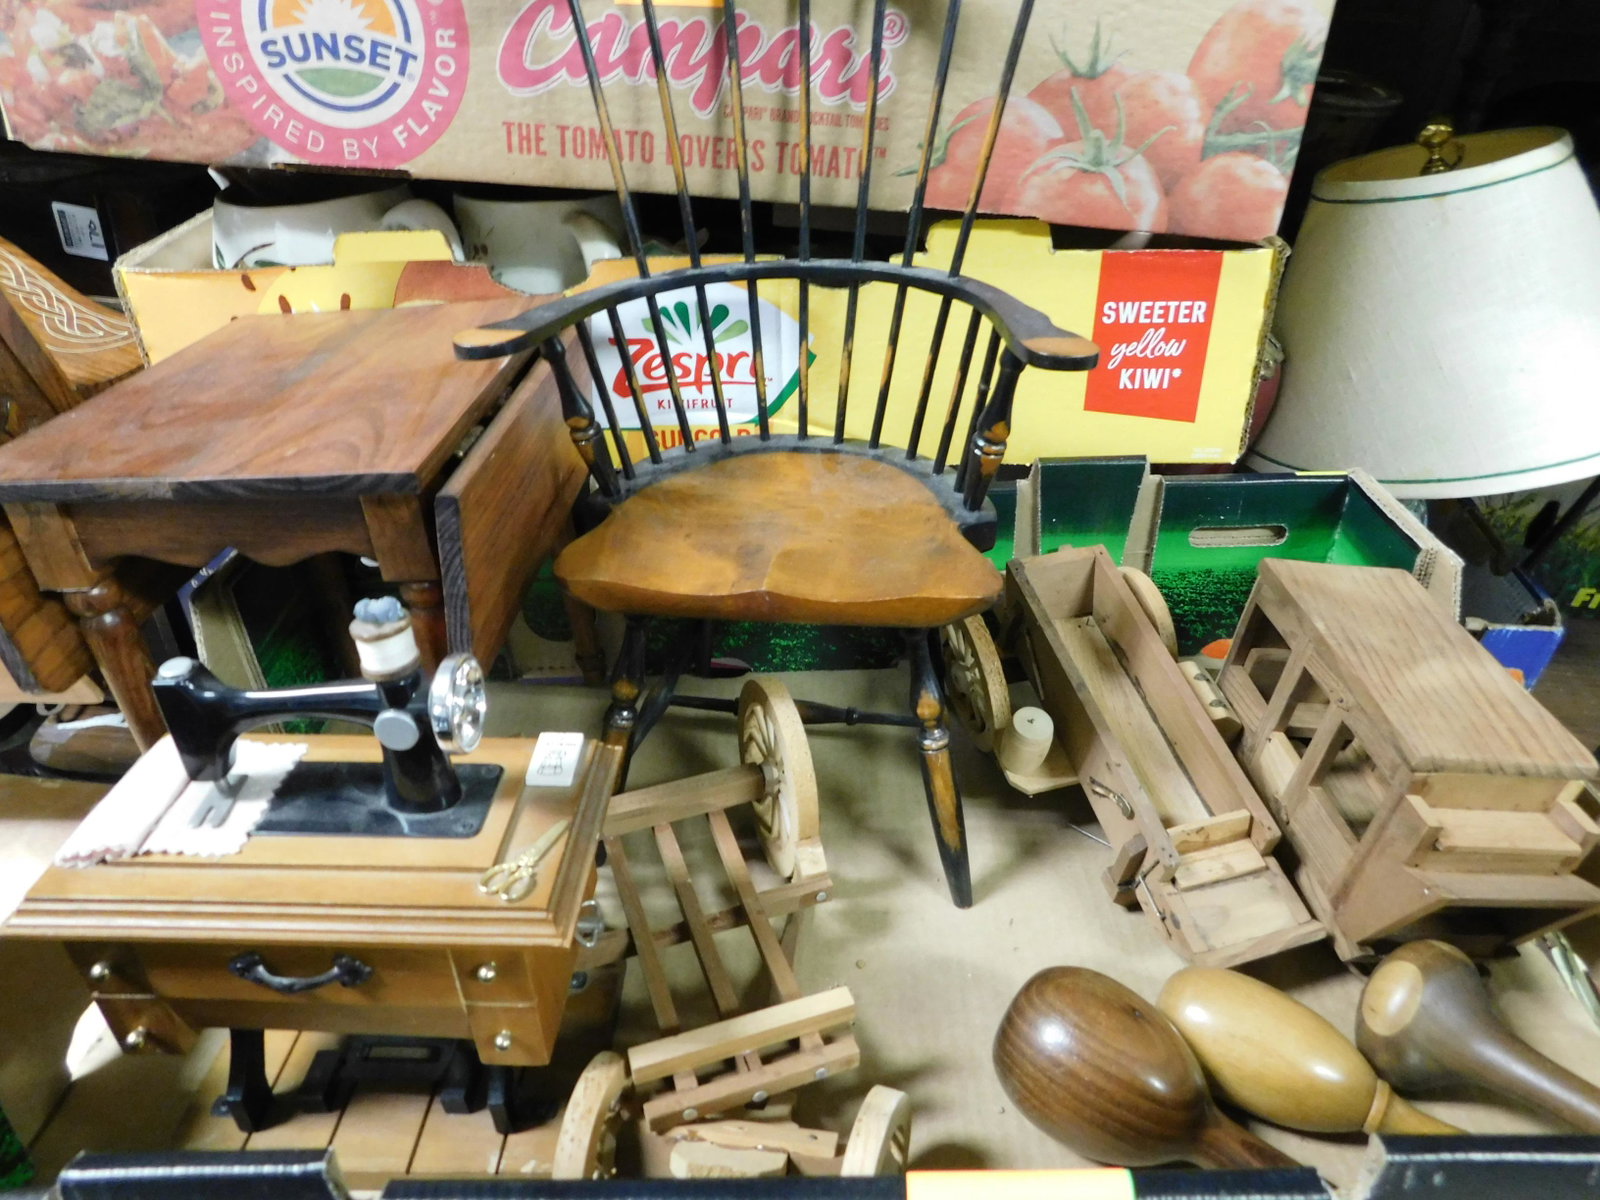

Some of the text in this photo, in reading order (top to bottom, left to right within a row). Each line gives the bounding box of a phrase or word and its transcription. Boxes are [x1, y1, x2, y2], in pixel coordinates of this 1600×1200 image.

[209, 11, 326, 153] INSPIRED
[342, 136, 381, 160] BY
[502, 121, 547, 156] THE
[1102, 300, 1207, 324] SWEETER
[1107, 327, 1187, 369] yellow
